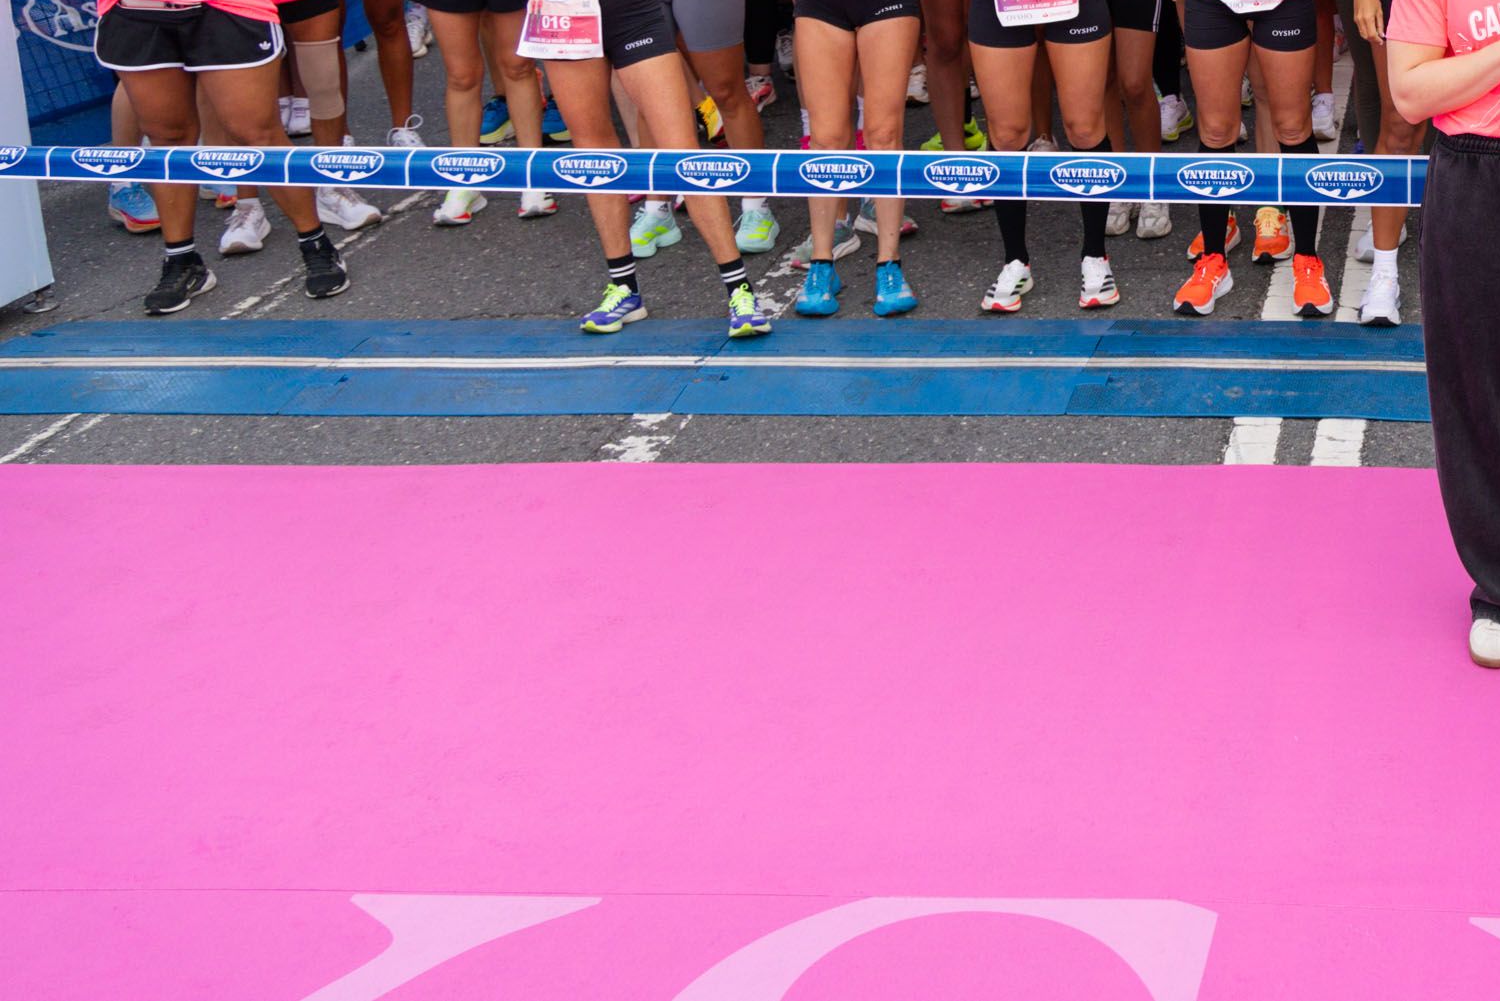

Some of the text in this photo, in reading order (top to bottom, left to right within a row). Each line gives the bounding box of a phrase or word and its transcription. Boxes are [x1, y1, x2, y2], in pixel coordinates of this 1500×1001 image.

[541, 15, 572, 29] 016
[1069, 25, 1099, 35] OYSHO
[1272, 28, 1300, 37] OYSHO
[625, 37, 653, 51] OYSHO
[197, 152, 260, 166] ASTURIANA
[318, 154, 380, 169] ASTURIANA
[438, 157, 500, 171] ASTURIANA
[559, 160, 622, 174] ASTURIANA
[682, 162, 744, 176] ASTURIANA
[806, 163, 870, 179] ASTURIANA
[930, 166, 994, 181] ASTURIANA
[1056, 168, 1120, 183] ASTURIANA
[1183, 169, 1249, 184] ASTURIANA
[1311, 171, 1378, 187] ASTURIANA
